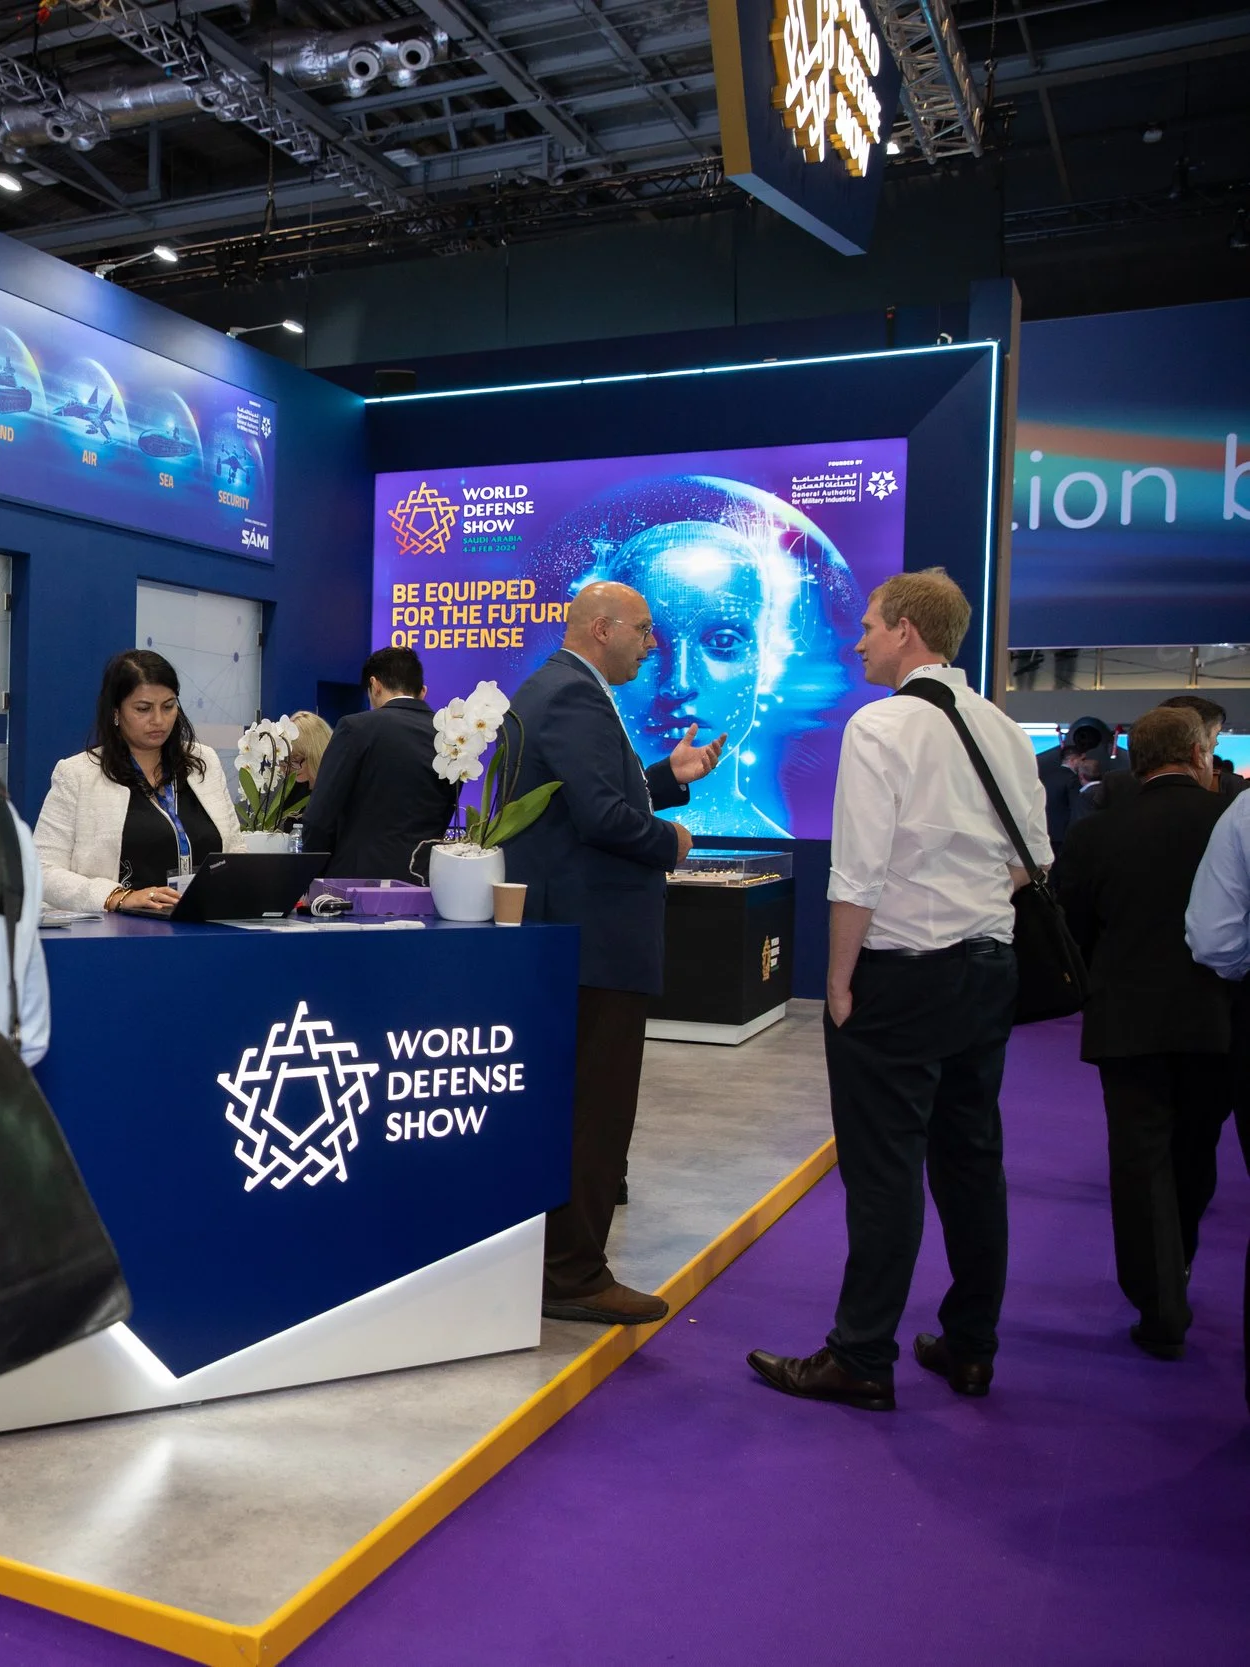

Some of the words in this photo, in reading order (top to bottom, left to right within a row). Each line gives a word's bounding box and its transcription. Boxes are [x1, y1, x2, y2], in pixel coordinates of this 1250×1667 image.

[82, 450, 97, 466] AIR
[159, 472, 174, 488] SEA
[463, 485, 528, 501] WORLD
[792, 490, 820, 498] General
[822, 489, 856, 497] Authority
[1012, 450, 1177, 531] ion
[218, 490, 249, 510] SECURITY
[463, 501, 535, 518] DEFENSE
[463, 518, 515, 534] SHOW
[463, 537, 488, 545] SAUDI
[491, 535, 522, 543] ARABIA
[495, 544, 516, 552] 2024
[393, 583, 420, 604] BE
[425, 579, 536, 605] EQUIPPED
[392, 606, 435, 627] FOR
[438, 604, 482, 625] THE
[391, 630, 420, 649] OF
[425, 627, 524, 649] DEFENSE
[386, 1024, 514, 1060] WORLD
[386, 1063, 526, 1101] DEFENSE
[385, 1105, 488, 1142] SHOW
